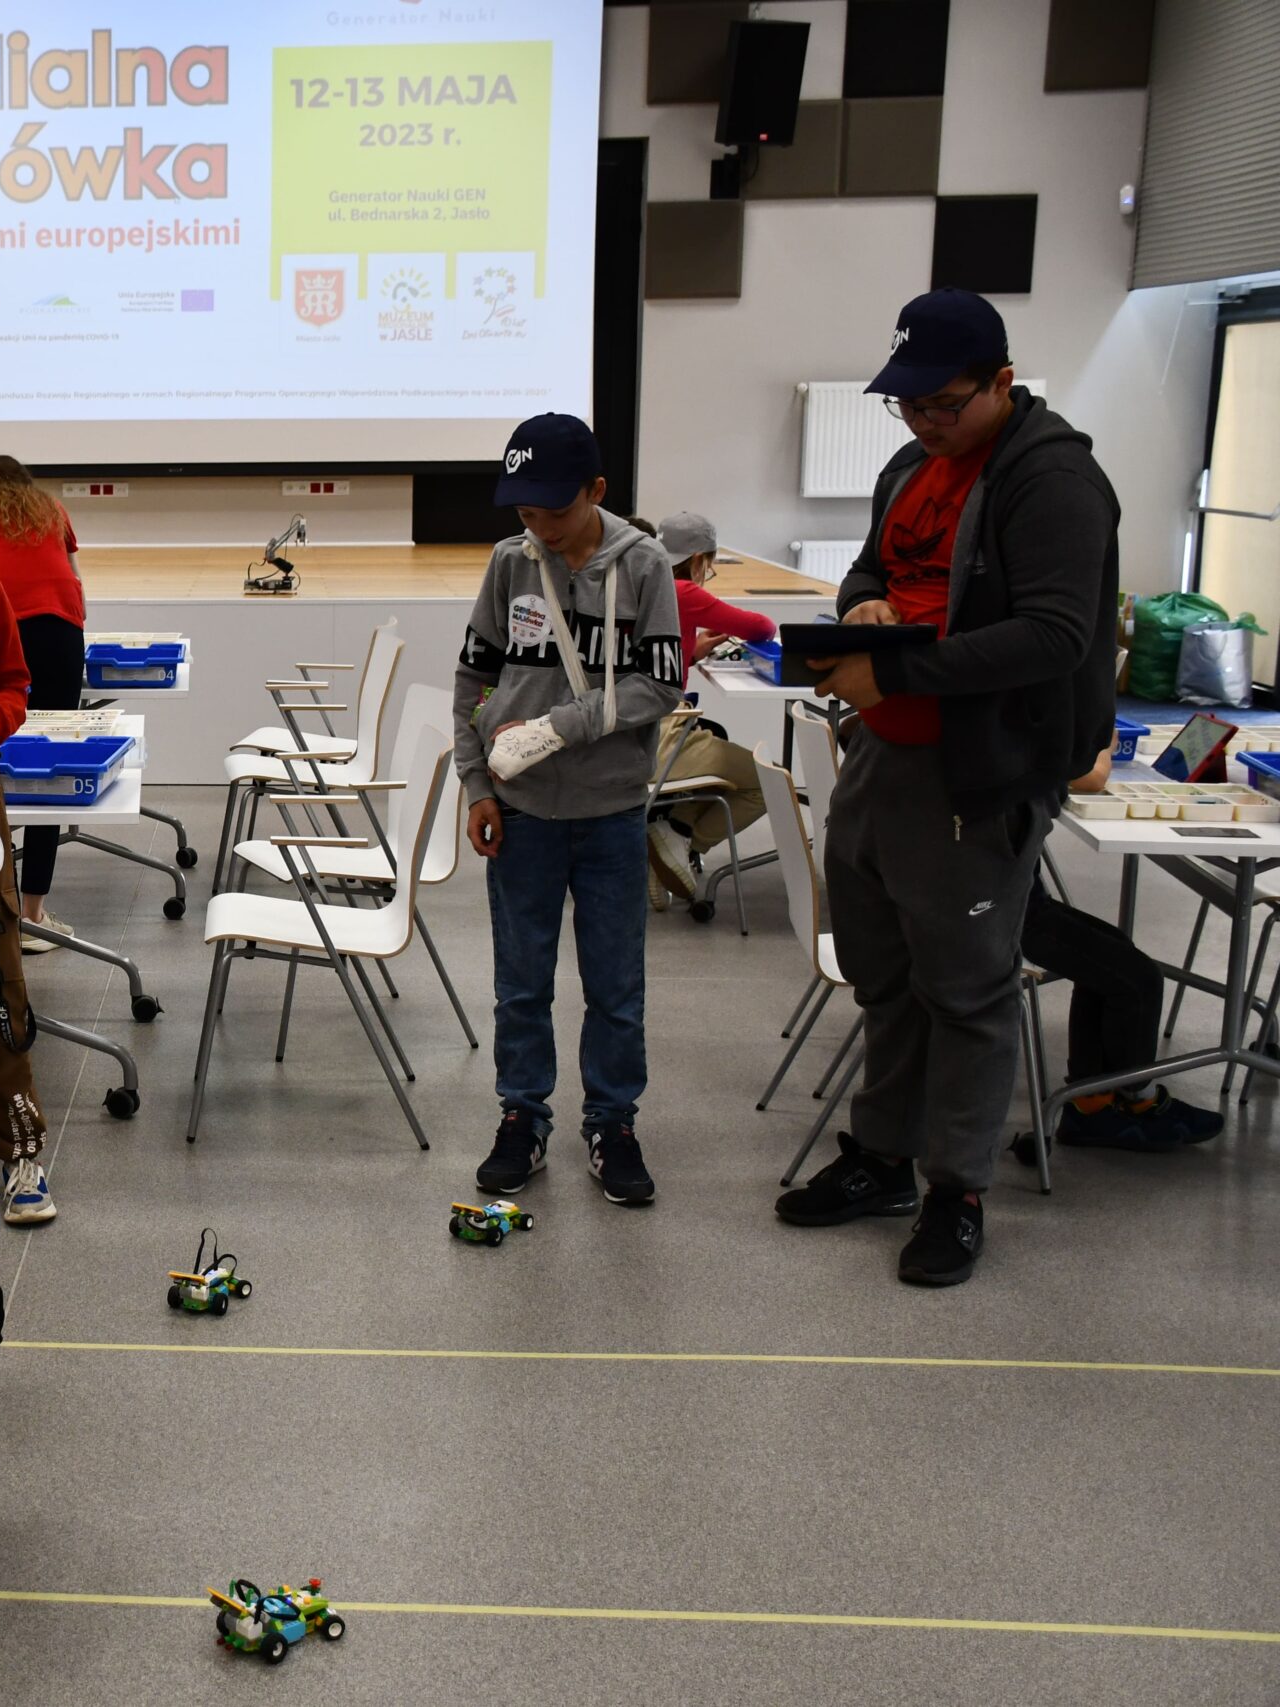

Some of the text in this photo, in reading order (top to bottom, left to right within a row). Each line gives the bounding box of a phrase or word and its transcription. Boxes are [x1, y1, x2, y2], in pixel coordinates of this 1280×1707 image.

[326, 8, 496, 26] Generator Nauki
[289, 74, 517, 109] 12-13 MAJA
[359, 123, 462, 147] 2023 r.
[328, 188, 486, 204] Generator Nauki GEN
[328, 207, 490, 222] ul. Bednarska 2, Jasło
[35, 218, 241, 253] europejskimi
[158, 669, 174, 681] 04
[73, 778, 95, 794] 05
